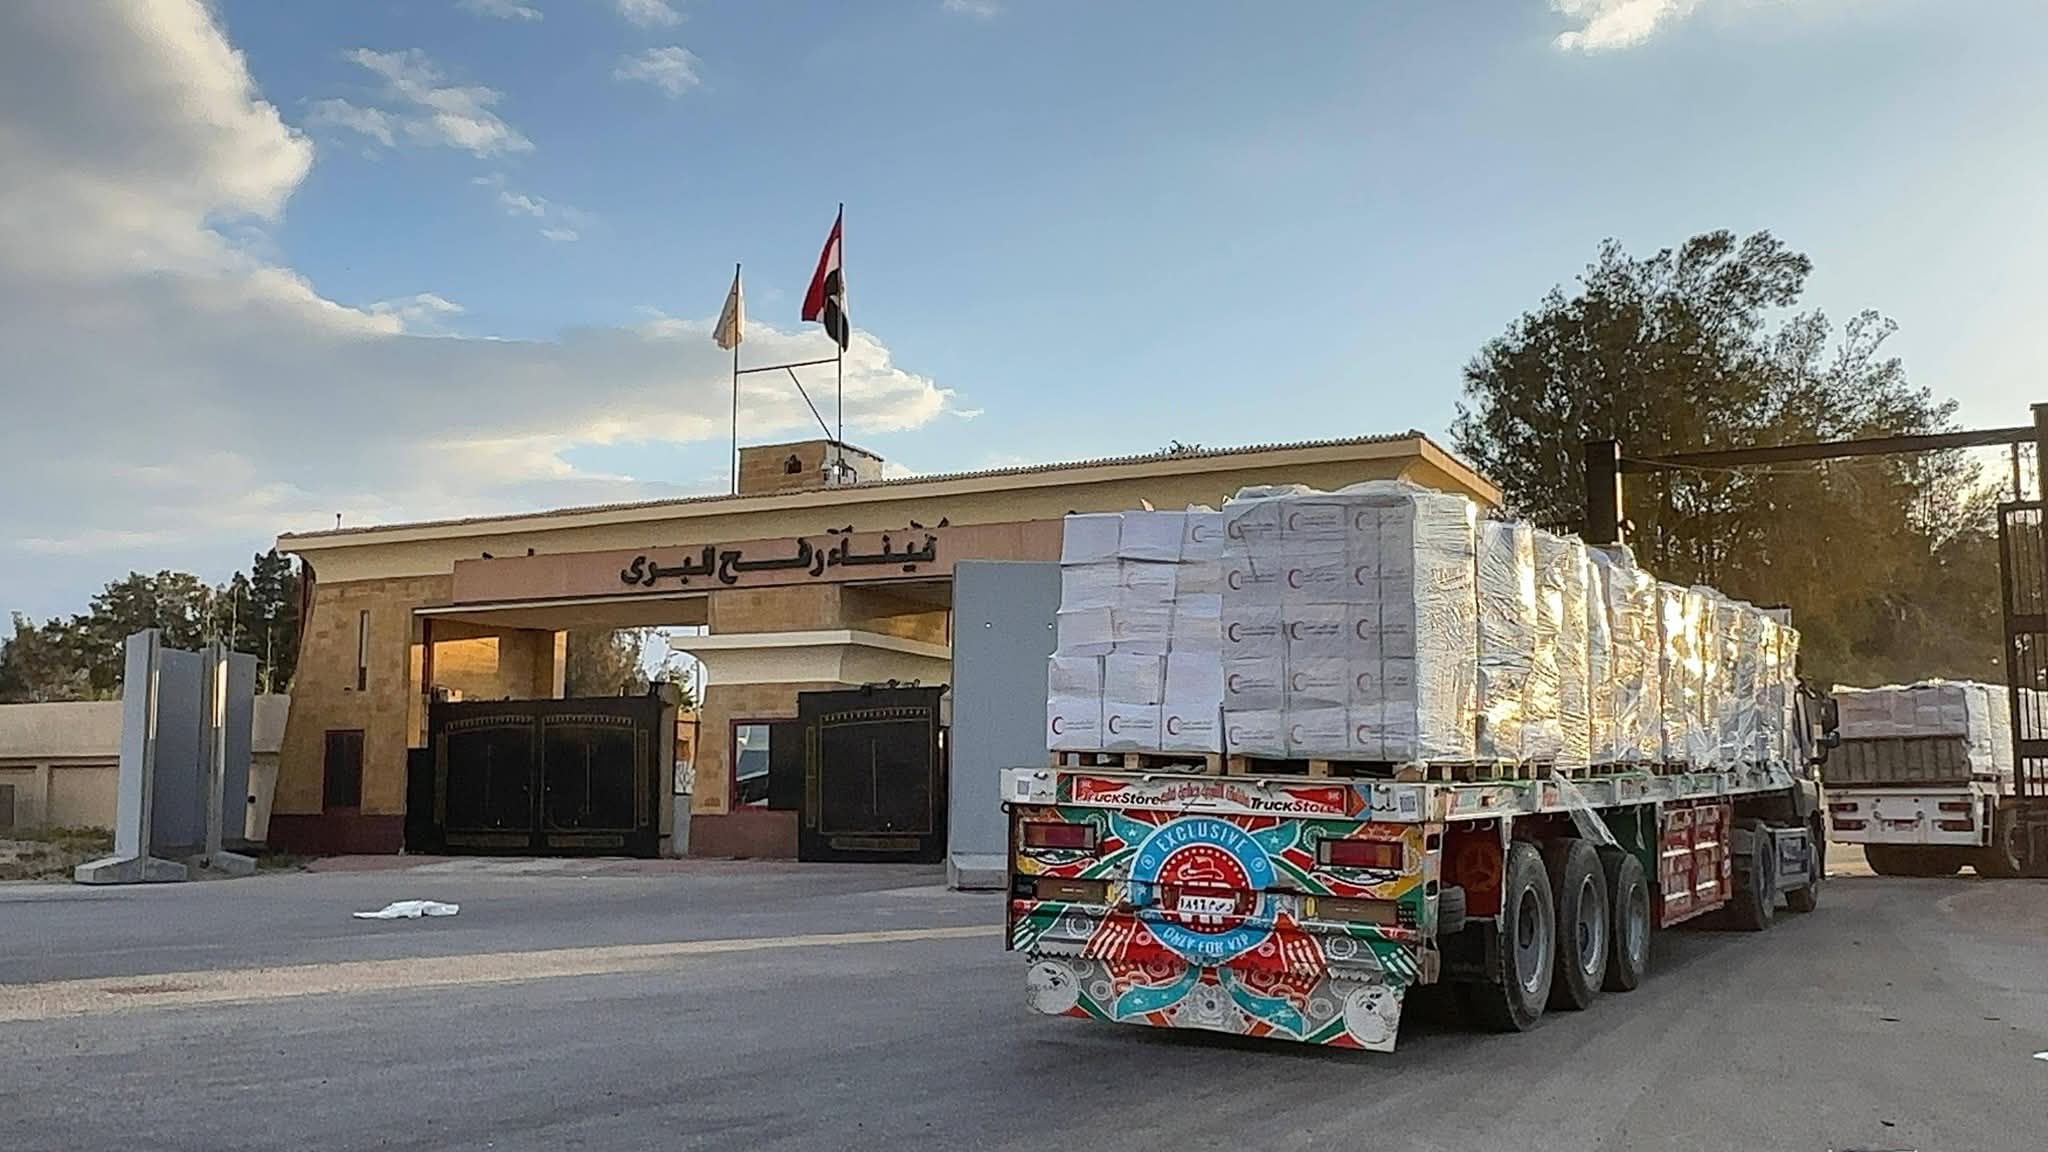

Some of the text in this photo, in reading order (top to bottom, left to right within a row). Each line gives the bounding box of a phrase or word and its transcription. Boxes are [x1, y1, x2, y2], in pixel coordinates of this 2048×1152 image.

[718, 536, 825, 585] رفح
[1155, 822, 1249, 853] EXCLUSIVE
[1163, 926, 1249, 954] ONLY FOR VIP
